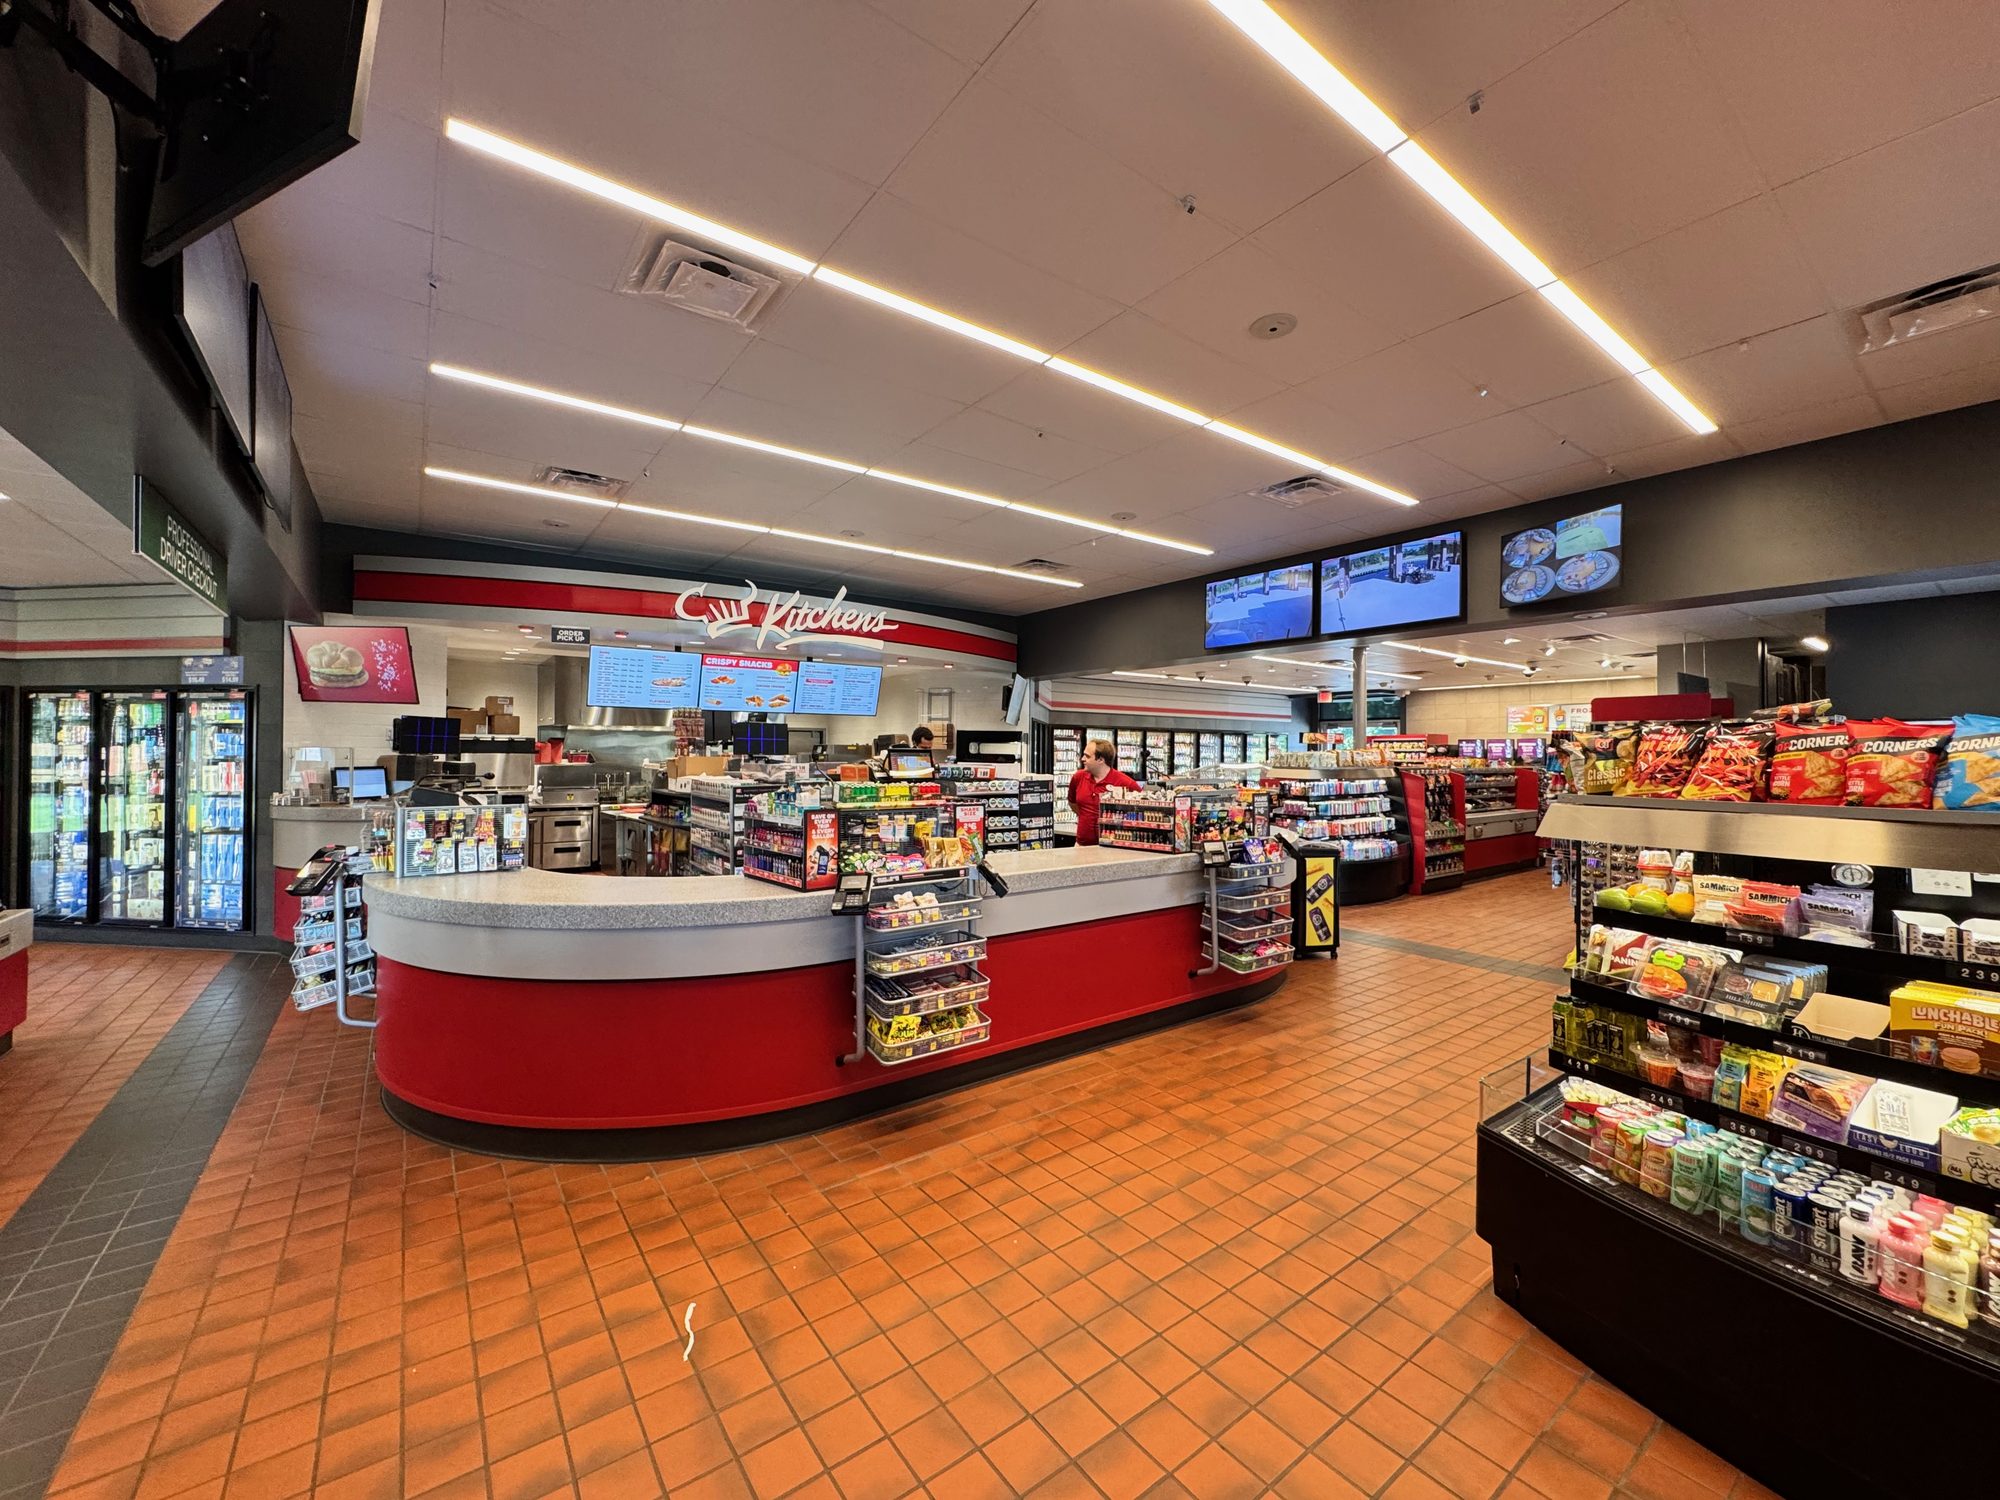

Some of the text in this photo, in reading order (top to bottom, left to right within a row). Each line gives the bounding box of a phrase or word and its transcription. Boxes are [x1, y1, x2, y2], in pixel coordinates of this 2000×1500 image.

[167, 514, 214, 576] PROFESSIONAL
[160, 536, 218, 600] DRIVER CHECKOUT
[756, 585, 899, 650] Kitchens
[705, 657, 773, 669] CRISPY SNACKS
[1587, 766, 1626, 781] Classic
[1700, 881, 1740, 893] SAMMICH
[1748, 893, 1791, 905] SAMMICH
[1807, 902, 1854, 917] SAMMICH
[1610, 955, 1640, 967] PANIN
[1911, 1006, 2000, 1033] LUNCHABLE
[1934, 1022, 1955, 1031] FUN
[1884, 1171, 1920, 1189] 249
[1774, 1196, 1786, 1235] smart
[1812, 1207, 1828, 1250] smart
